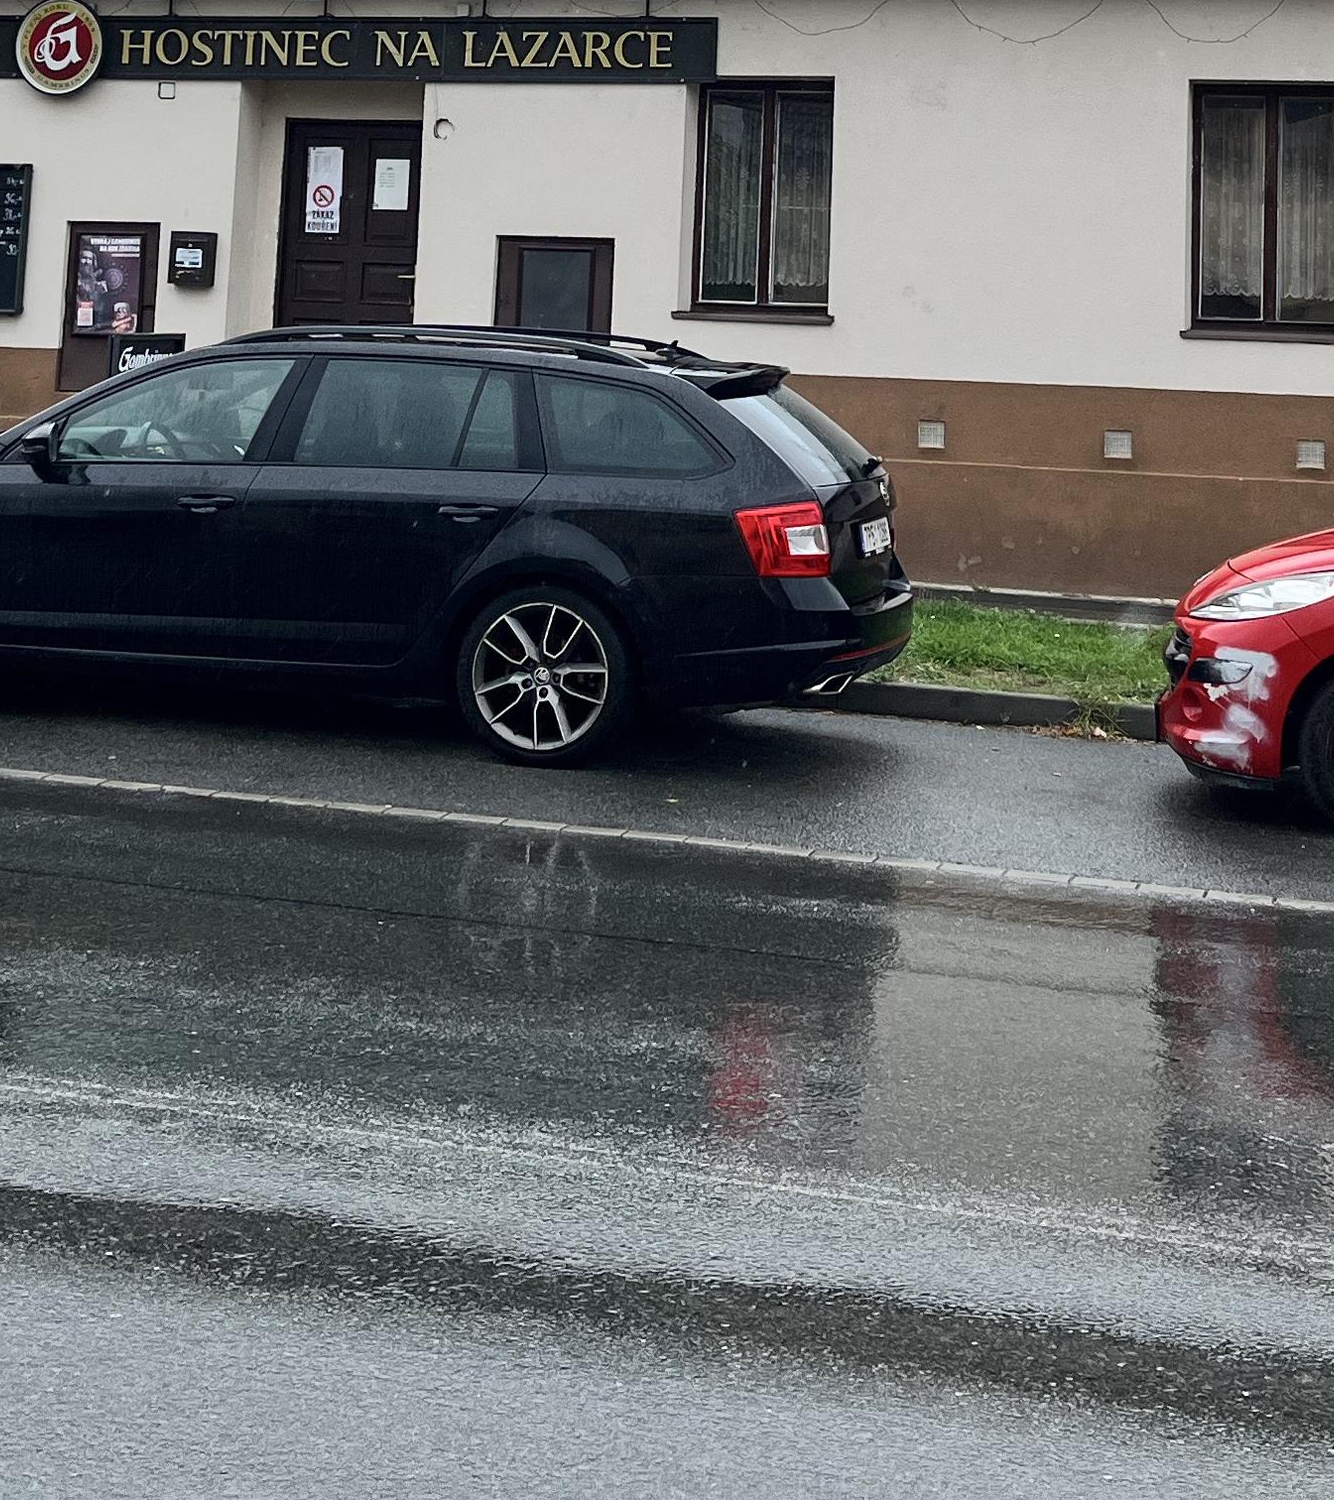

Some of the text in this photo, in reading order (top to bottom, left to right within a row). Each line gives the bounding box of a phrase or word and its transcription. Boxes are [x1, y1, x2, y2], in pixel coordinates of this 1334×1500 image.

[120, 29, 674, 68] HOSTINEC NA LAZARCE
[312, 209, 334, 219] ZÁKAZ
